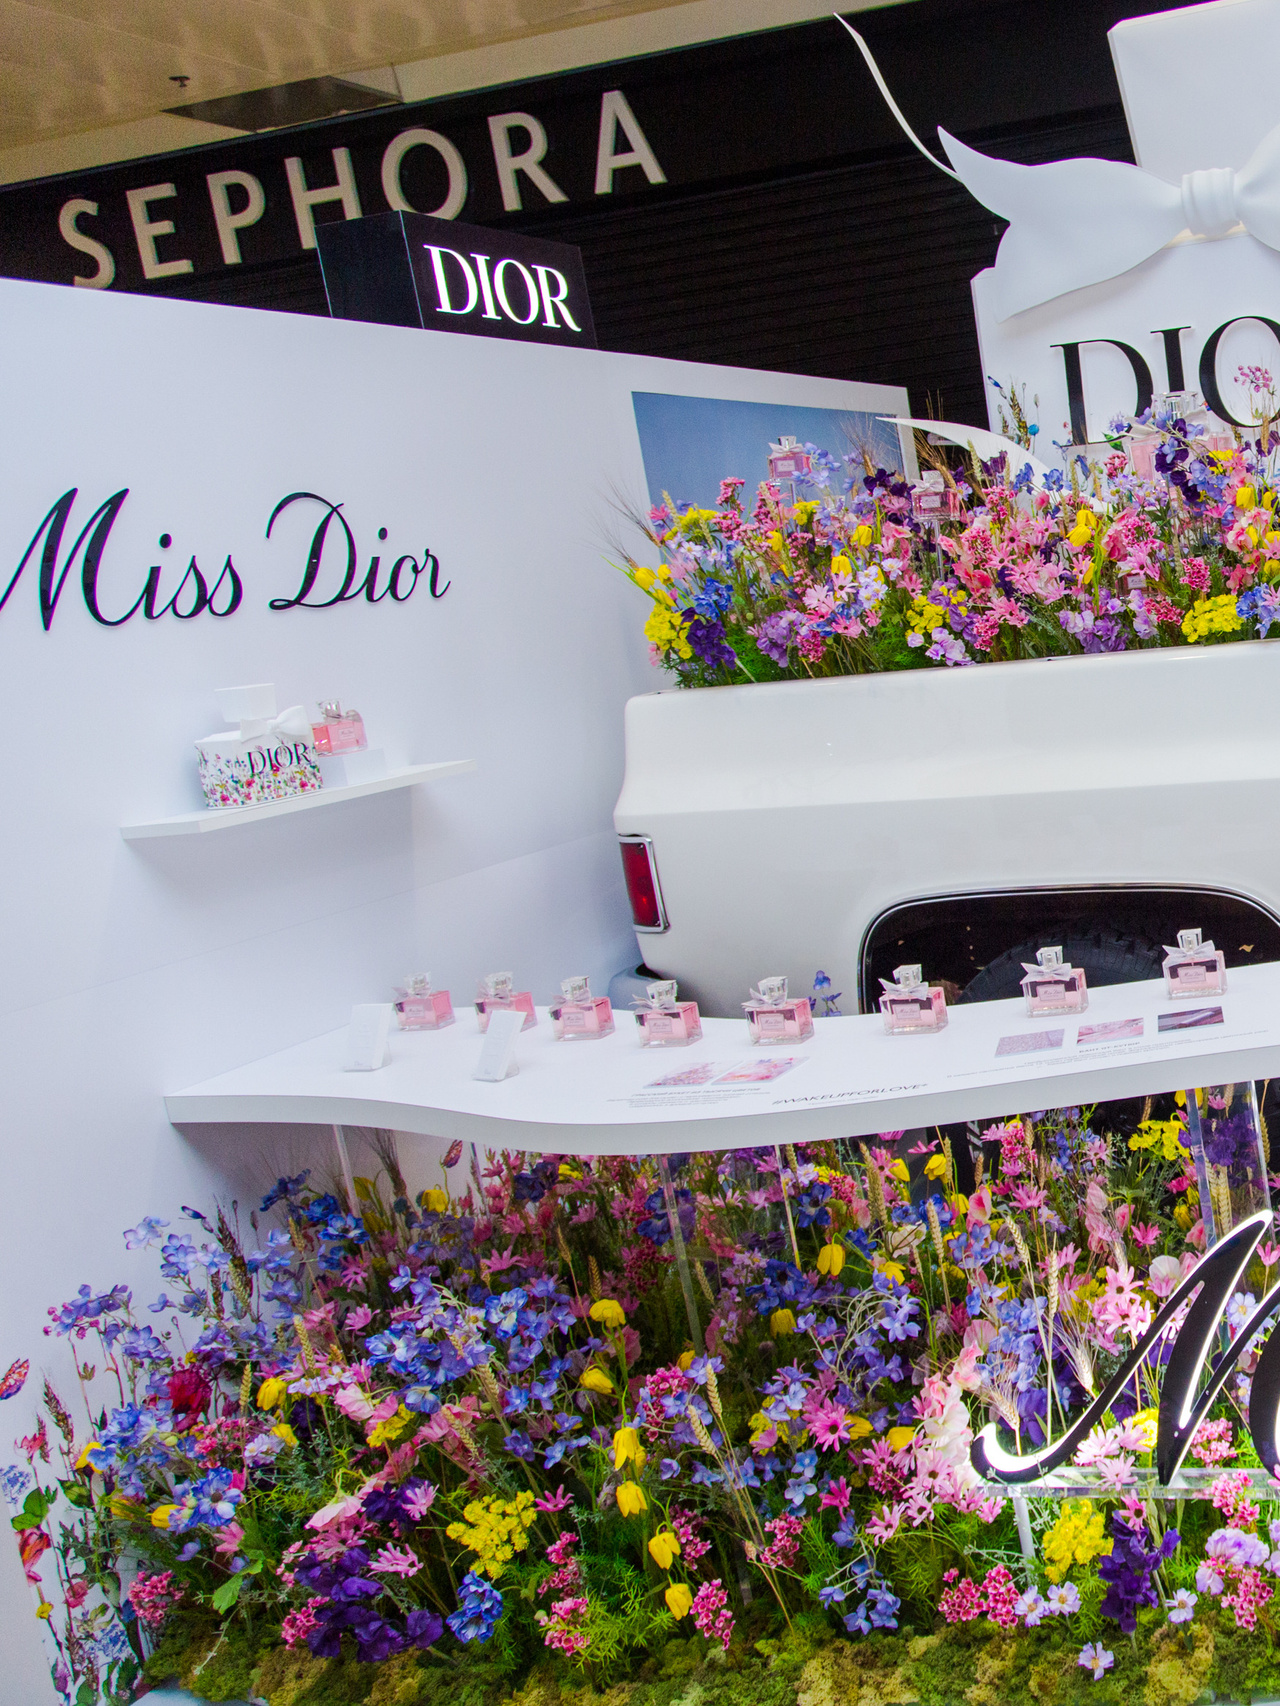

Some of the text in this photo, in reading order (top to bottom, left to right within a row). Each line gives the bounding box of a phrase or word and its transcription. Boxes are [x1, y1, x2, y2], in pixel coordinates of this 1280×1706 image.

[57, 89, 669, 291] SEPHORA
[423, 243, 582, 333] DIOR
[0, 487, 451, 633] Miss Dior
[246, 741, 312, 777] DIOR
